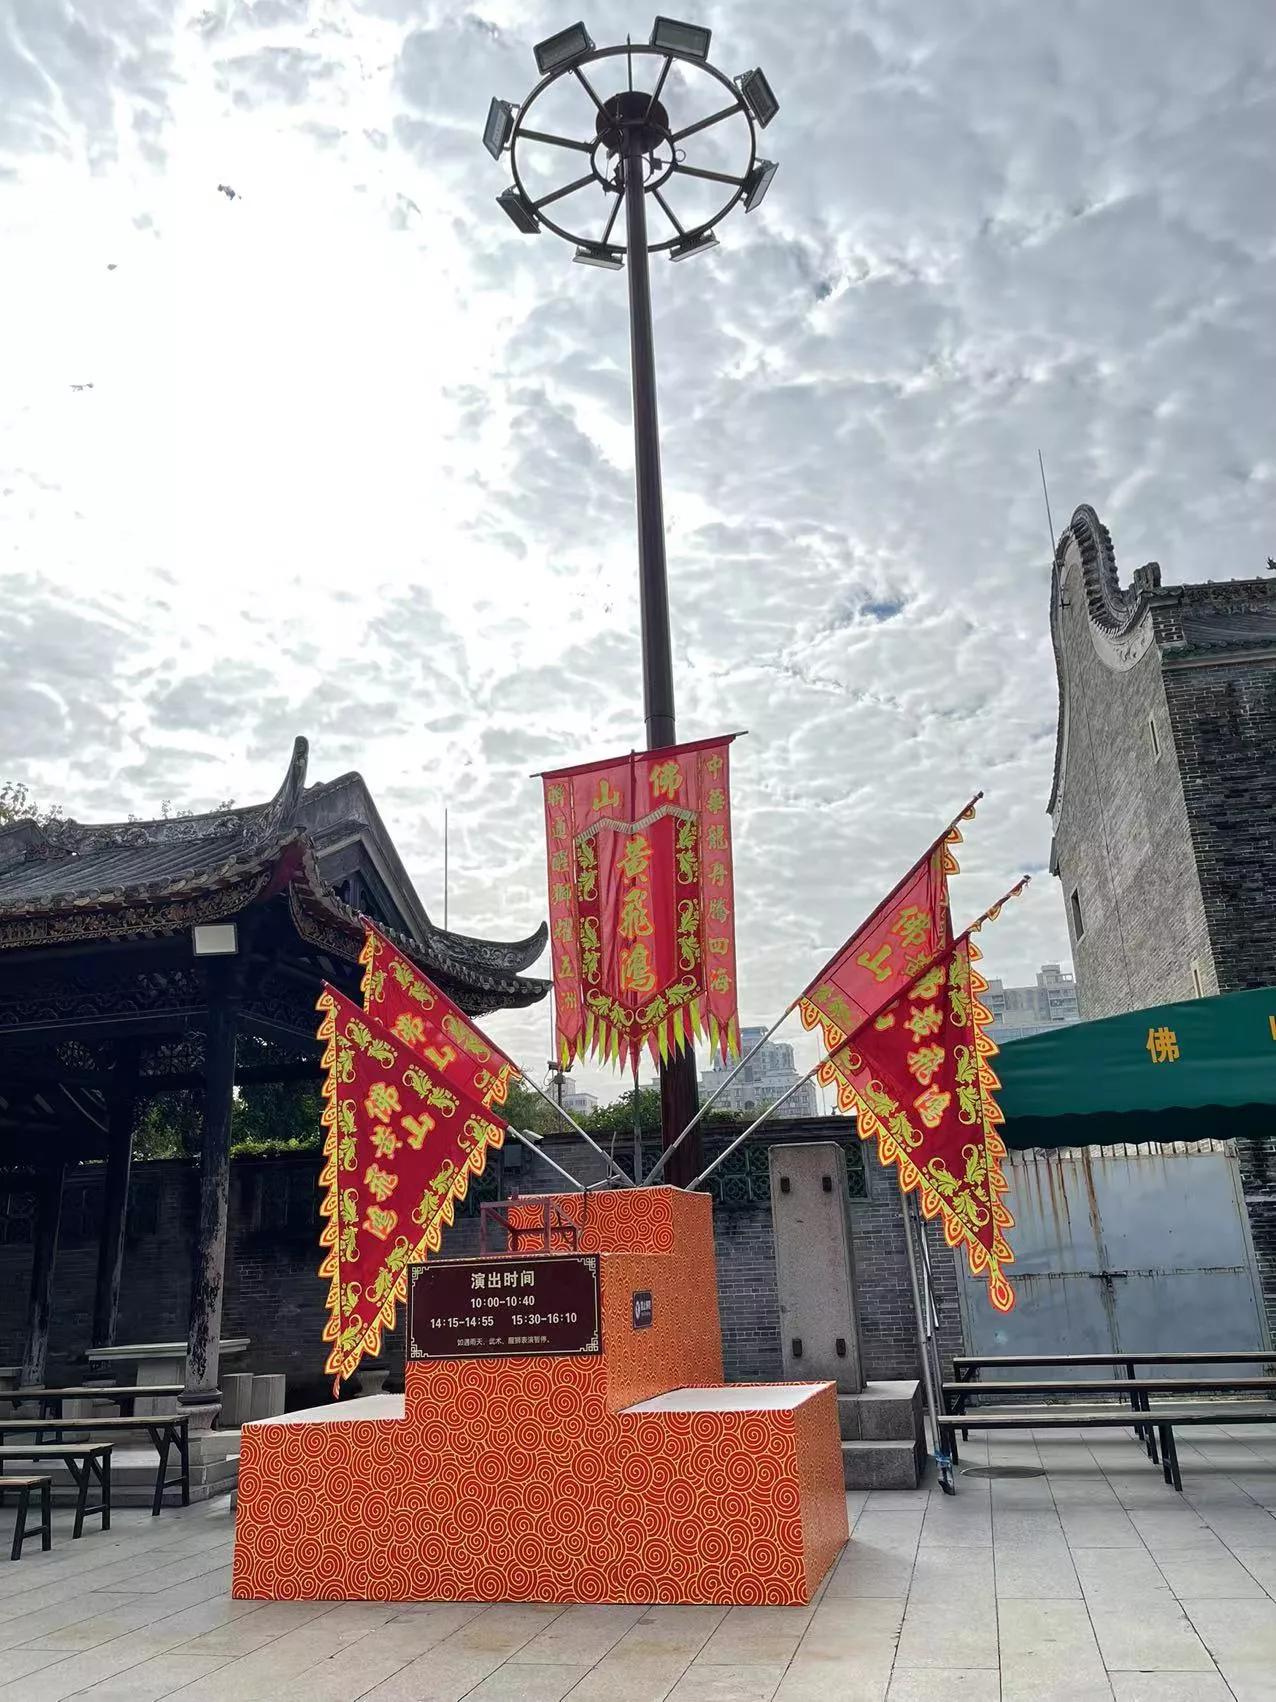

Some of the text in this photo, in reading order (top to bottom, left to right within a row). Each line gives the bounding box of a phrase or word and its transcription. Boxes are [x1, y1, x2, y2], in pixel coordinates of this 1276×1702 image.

[592, 761, 684, 812] 佛山
[1146, 1027, 1181, 1063] 佛
[471, 1270, 535, 1290] 演出时间
[470, 1295, 535, 1308] 10:00-10:40
[430, 1312, 577, 1329] 14:15-14:55 15:30-16:10
